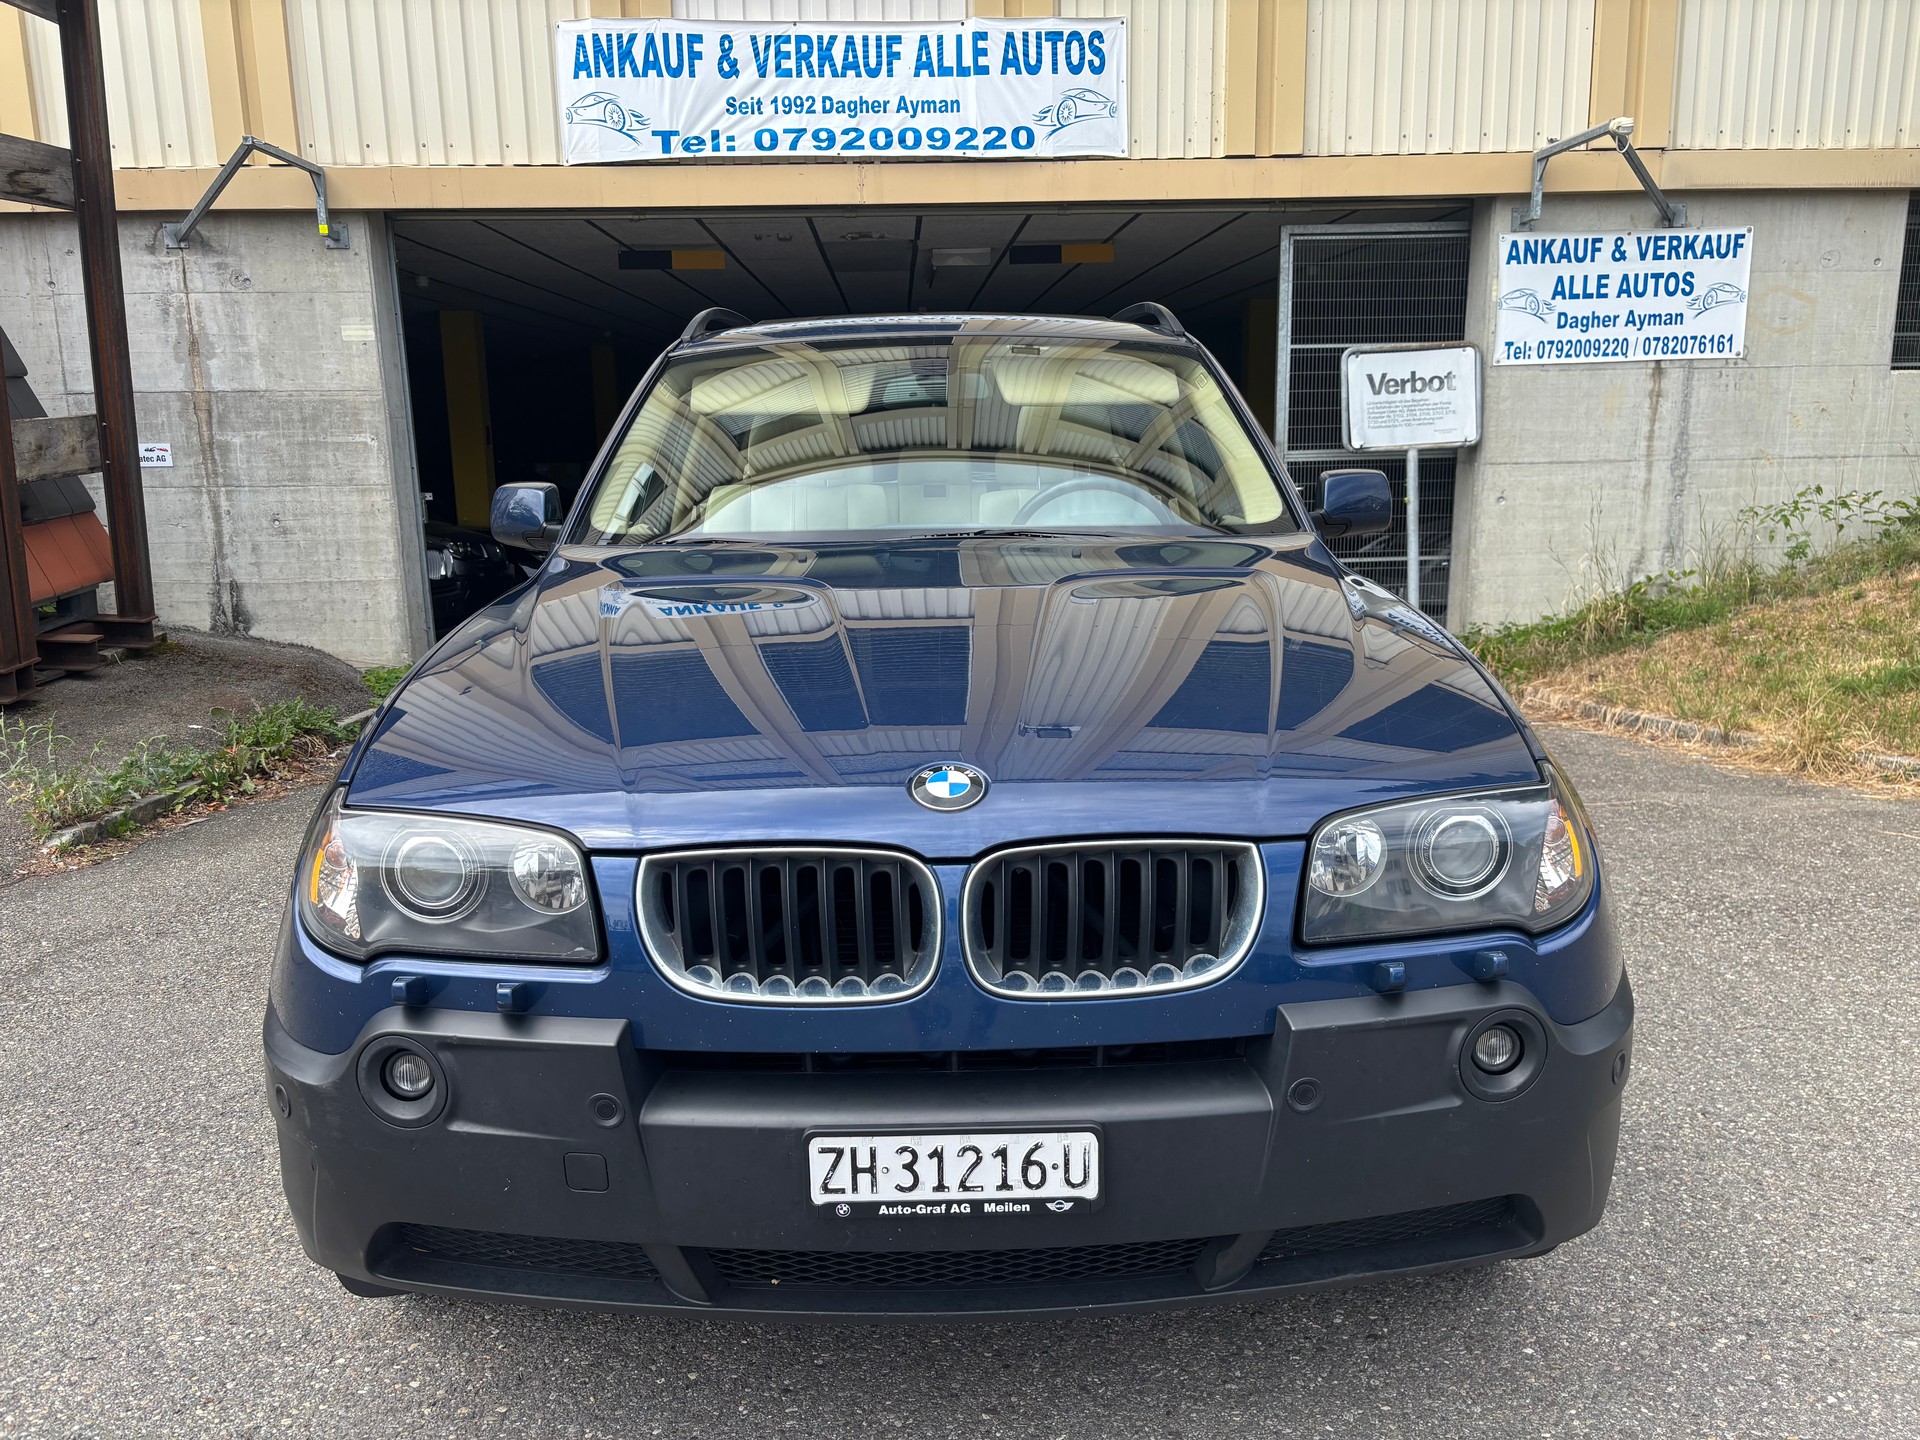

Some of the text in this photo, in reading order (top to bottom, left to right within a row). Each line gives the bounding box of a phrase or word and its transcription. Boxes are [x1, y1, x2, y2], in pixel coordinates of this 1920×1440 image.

[573, 30, 1107, 80] ANKAUF & VERKAUF ALLE AUTOS
[725, 95, 961, 119] Seit 1992 Dagher Ayman
[651, 126, 1036, 154] Tel: 0792009220
[1506, 233, 1746, 265] ANKAUF & VERKAUF
[1551, 271, 1695, 300] ALLE AUTOS
[1556, 310, 1684, 333] Dagher Ayman
[1504, 334, 1734, 360] Tel: 0792009220 / 0782076161
[1366, 371, 1456, 395] Verbot
[920, 766, 977, 777] BMW
[878, 1202, 1031, 1215] Auto-Graf AG Meilen
